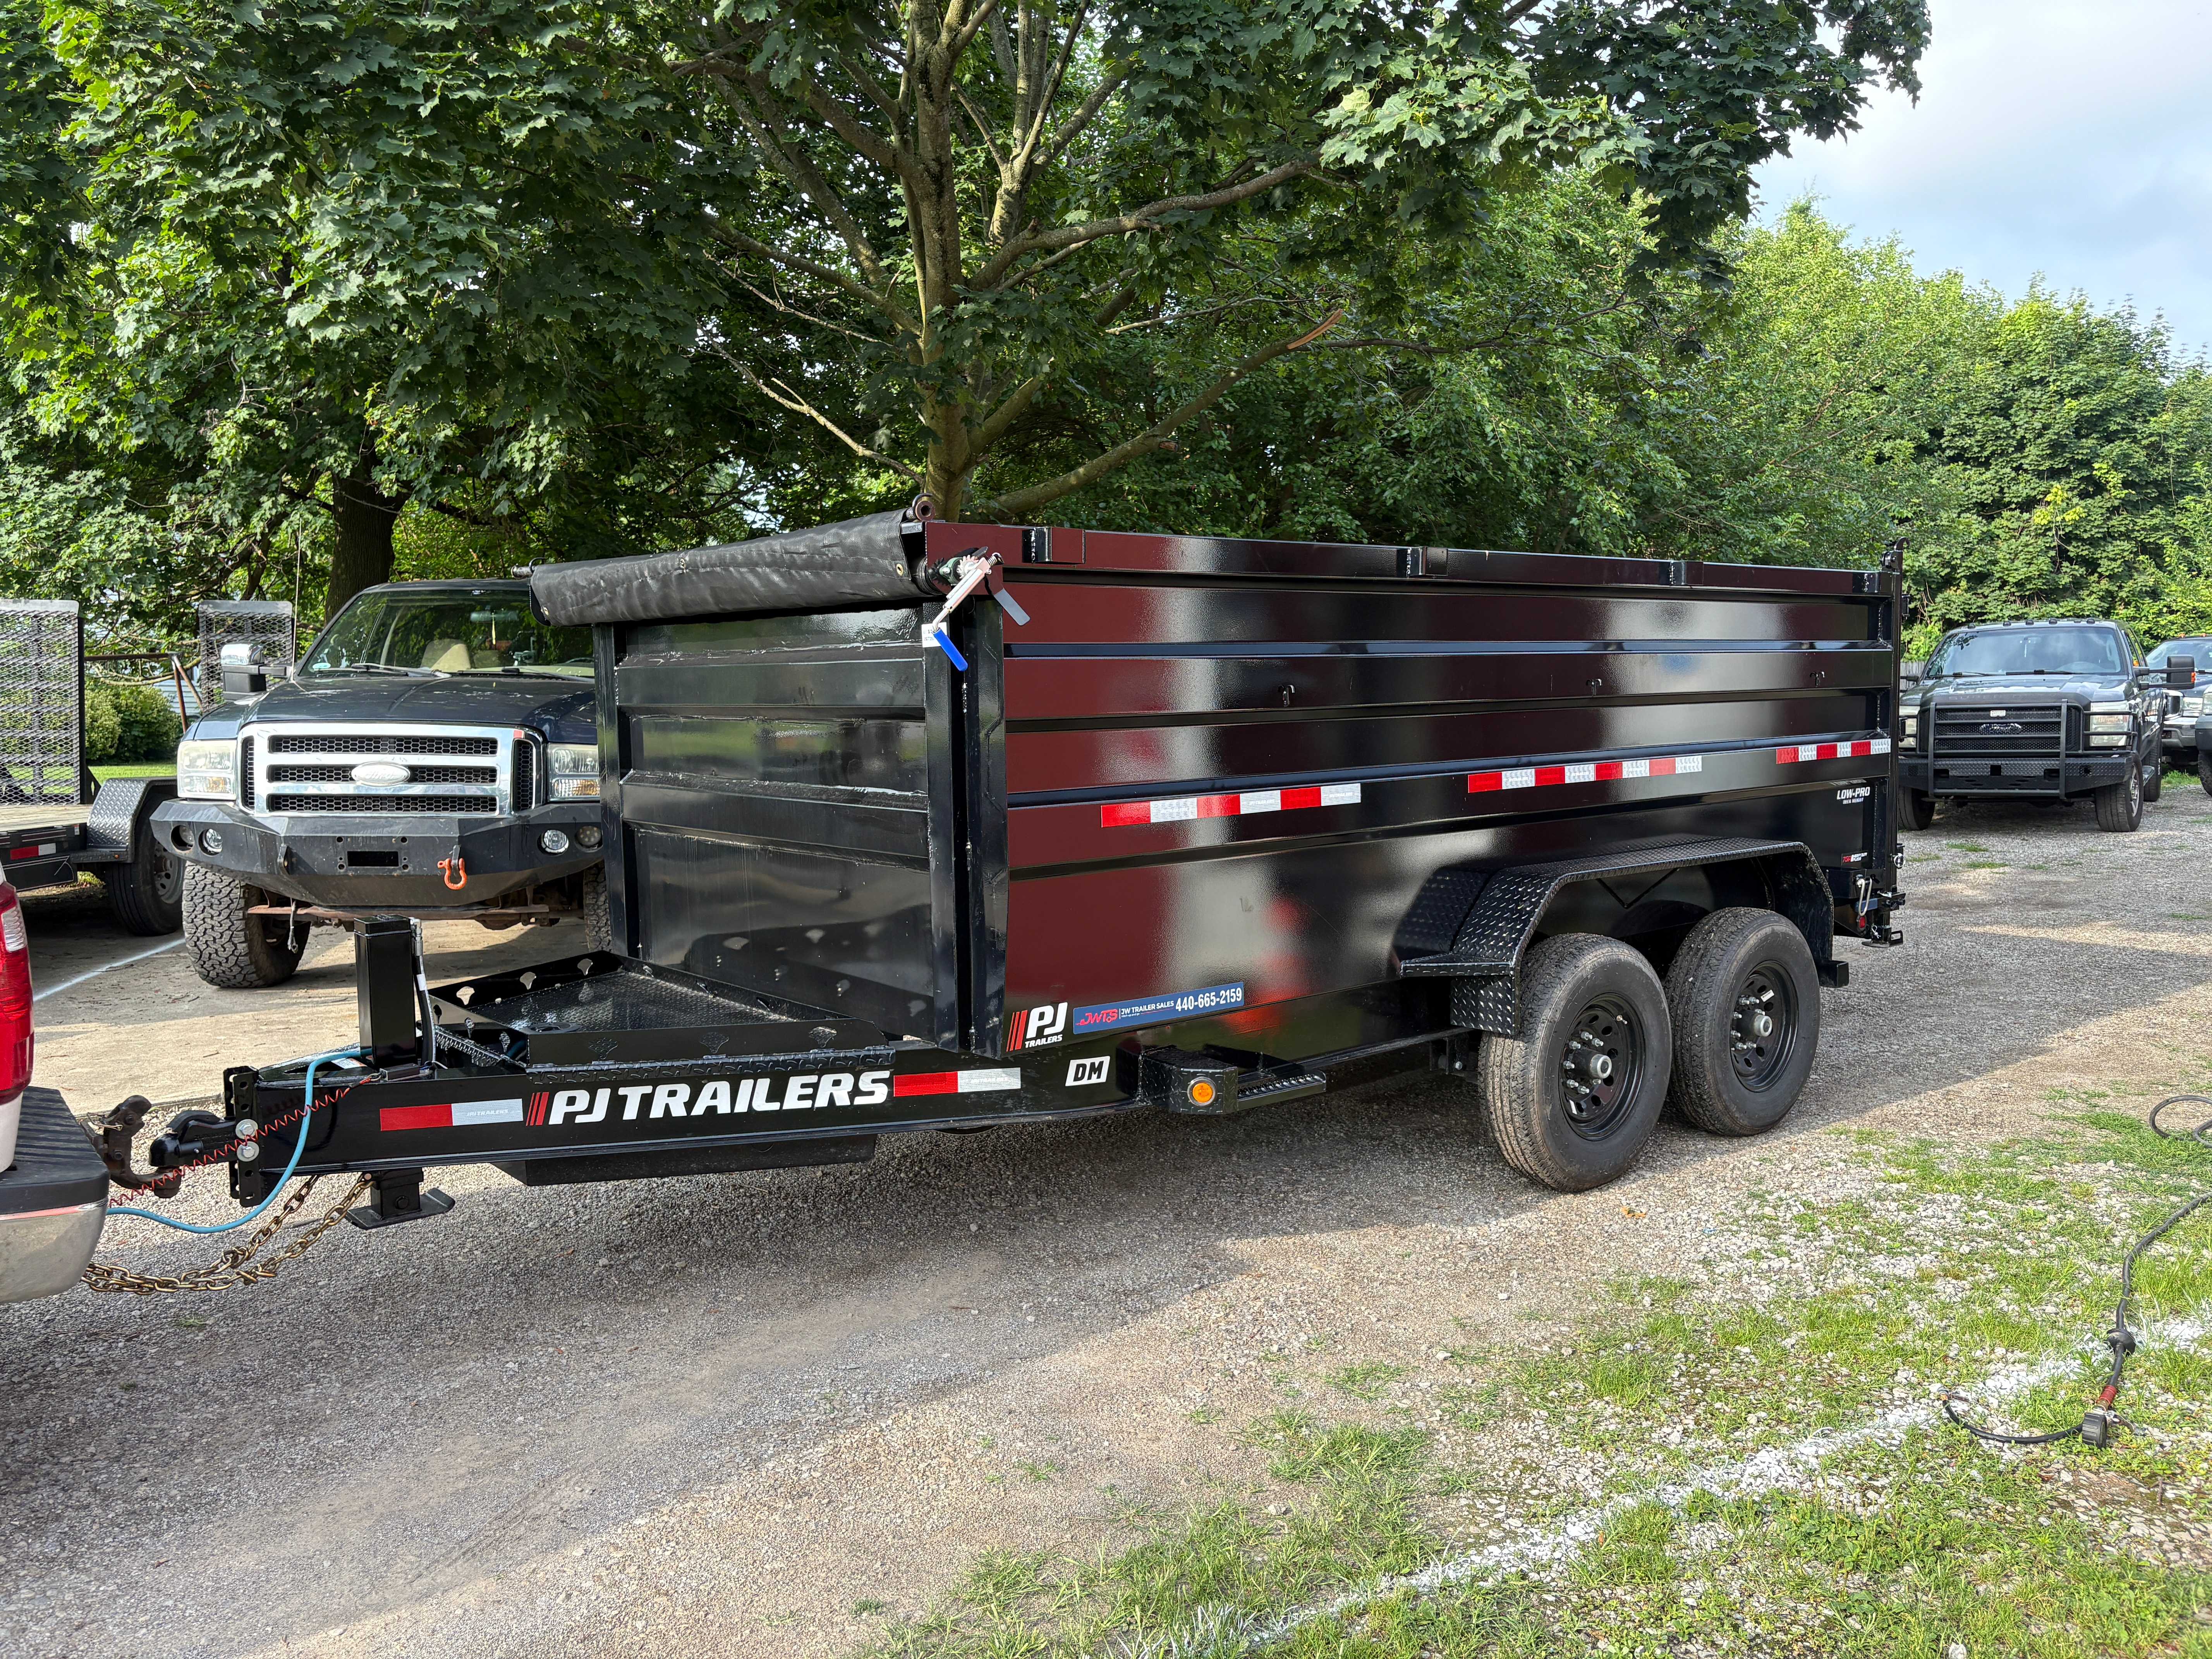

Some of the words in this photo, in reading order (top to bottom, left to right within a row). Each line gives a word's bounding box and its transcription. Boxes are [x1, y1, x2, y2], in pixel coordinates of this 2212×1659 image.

[1837, 787, 1870, 800] LOW-PRO
[1131, 1004, 1156, 1013] TRAILER
[1156, 1001, 1174, 1009] SALES
[1176, 988, 1242, 1012] 440-665-2159
[1026, 1002, 1068, 1039] PJ
[1084, 1008, 1118, 1024] JWTS
[1025, 1034, 1063, 1048] TRAILERS
[1073, 1061, 1104, 1082] DM
[548, 1088, 611, 1125] PJ
[618, 1070, 890, 1120] TRAILERS
